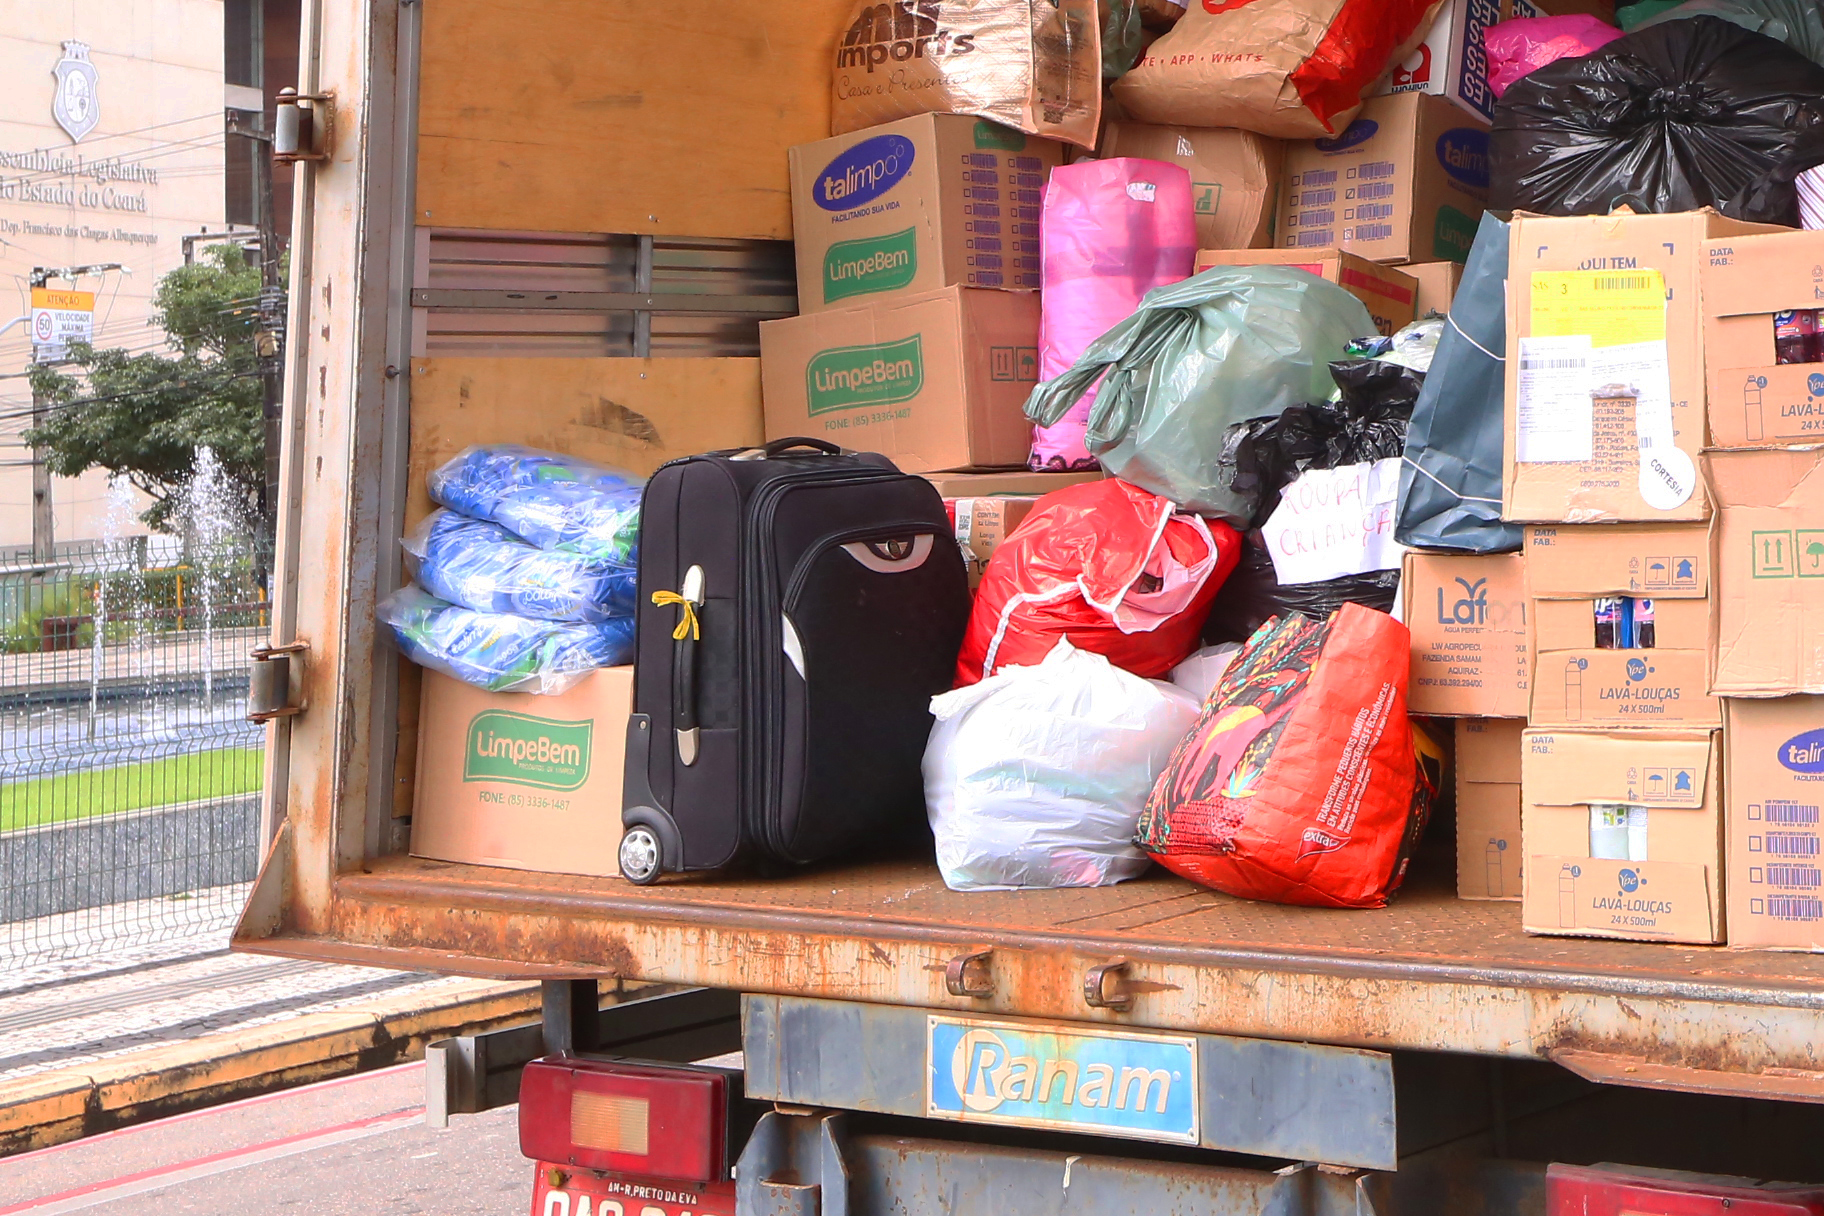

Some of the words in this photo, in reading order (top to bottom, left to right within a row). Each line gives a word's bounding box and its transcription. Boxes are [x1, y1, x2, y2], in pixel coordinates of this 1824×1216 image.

[836, 31, 976, 74] imports
[1170, 54, 1195, 67] APP
[1211, 52, 1265, 65] WHATS
[1444, 140, 1490, 175] talimp
[78, 154, 159, 186] Legislativa
[823, 154, 898, 202] talimpo
[19, 178, 74, 206] Estado
[79, 184, 99, 209] do
[102, 187, 148, 213] Ceará
[831, 207, 870, 224] FACILITANDO
[871, 203, 885, 216] SUA
[885, 200, 901, 212] VIDA
[23, 220, 63, 237] Francisco
[64, 224, 79, 238] das
[1439, 221, 1471, 250] Limp
[1710, 247, 1734, 257] DATA
[830, 247, 909, 282] LimpeBem
[1577, 257, 1606, 271] QUI
[1610, 256, 1637, 270] TEM
[1710, 257, 1734, 267] FAB.:
[47, 294, 80, 308] ATENÇÃO
[39, 319, 50, 331] 50
[55, 312, 90, 322] VELOCIDADE
[815, 359, 914, 392] LimpeBem
[852, 415, 869, 428] (85)
[871, 407, 911, 424] 3336-1487
[1801, 421, 1812, 430] 24
[1814, 420, 1821, 429] X
[1650, 457, 1684, 498] CORTESIA
[1284, 474, 1361, 515] ROUPA
[1280, 509, 1391, 556] CRIANÇA
[1534, 529, 1557, 537] DATA
[1533, 538, 1556, 547] FAB.:
[1431, 643, 1443, 651] LW
[1444, 643, 1482, 652] AGROPEC
[1422, 654, 1455, 663] FAZENDA
[1448, 667, 1479, 675] AQUIRAZ
[1600, 687, 1681, 703] LAVA-LOUÇAS
[1619, 704, 1629, 714] 24
[1630, 704, 1637, 713] X
[1638, 704, 1665, 714] 500ml
[477, 730, 580, 766] LimpeBem
[1531, 735, 1555, 745] DATA
[1345, 734, 1370, 781] CONSCIENTES
[1531, 745, 1554, 754] FAB.:
[1316, 774, 1343, 823] TRANSFORME
[1337, 737, 1358, 776] PEQUENOS
[1351, 707, 1371, 737] HÁBITOS
[508, 793, 524, 807] (85)
[527, 795, 570, 811] 3336-1487
[1331, 778, 1351, 817] ATITUDES
[1326, 815, 1337, 828] EM
[1303, 830, 1331, 847] extra
[1592, 897, 1673, 915] LAVA-LOUÇAS
[1611, 915, 1621, 924] 24
[1622, 916, 1629, 925] X
[1630, 916, 1657, 927] 500ml
[953, 1028, 1173, 1115] Ranam
[665, 1190, 677, 1203] DA
[678, 1192, 698, 1205] EVA
